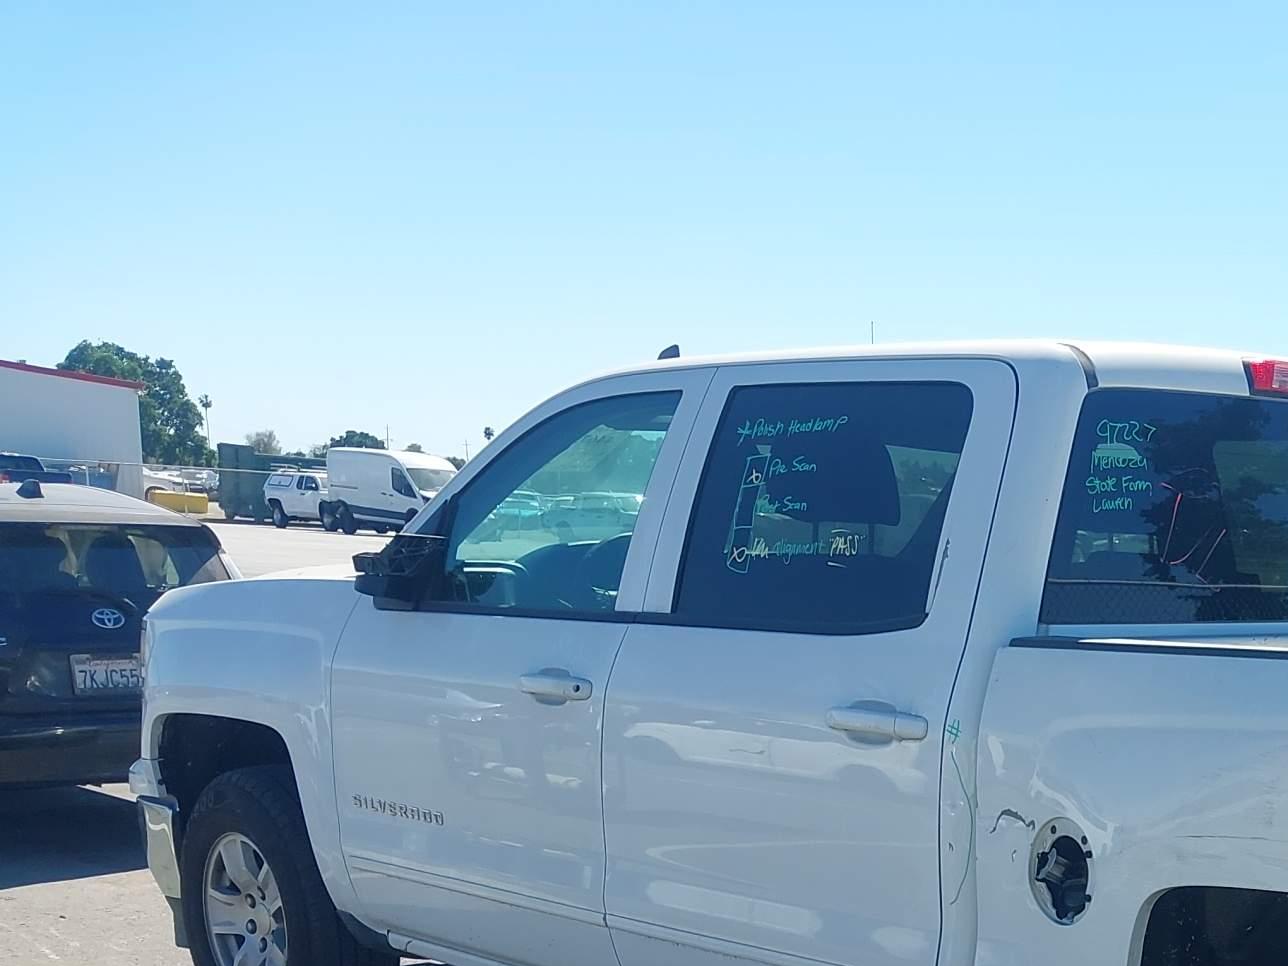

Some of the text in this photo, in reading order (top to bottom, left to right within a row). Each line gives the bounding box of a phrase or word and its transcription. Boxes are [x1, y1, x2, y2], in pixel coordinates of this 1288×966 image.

[791, 456, 817, 473] Scan
[1085, 475, 1153, 496] State Farm
[782, 496, 808, 512] Scan
[352, 794, 445, 827] SILVERADO
